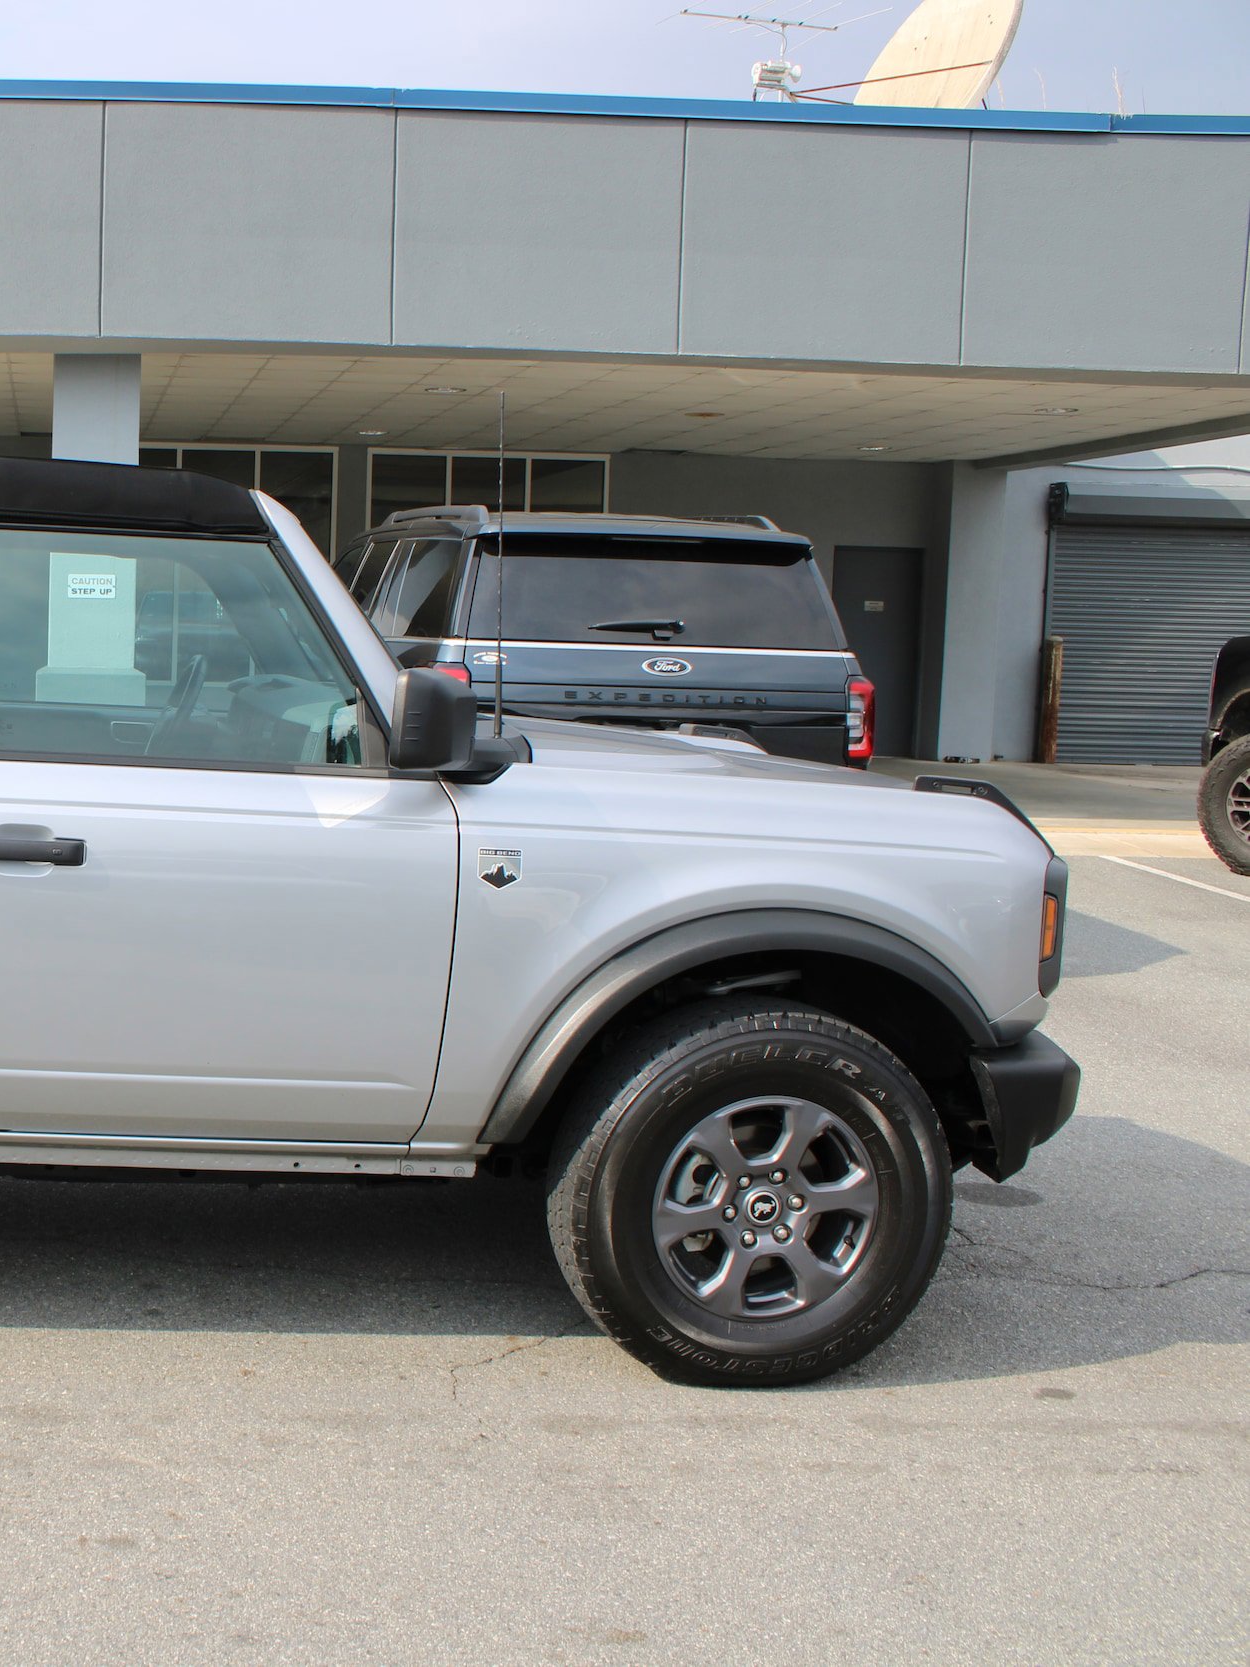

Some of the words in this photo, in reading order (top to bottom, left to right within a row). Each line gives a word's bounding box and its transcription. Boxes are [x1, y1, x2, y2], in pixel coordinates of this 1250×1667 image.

[71, 577, 113, 586] CAUTION
[71, 587, 96, 595] STEP
[99, 588, 113, 596] UP
[654, 660, 681, 673] Ford
[564, 690, 768, 705] EXPEDITION
[497, 849, 521, 857] BEND
